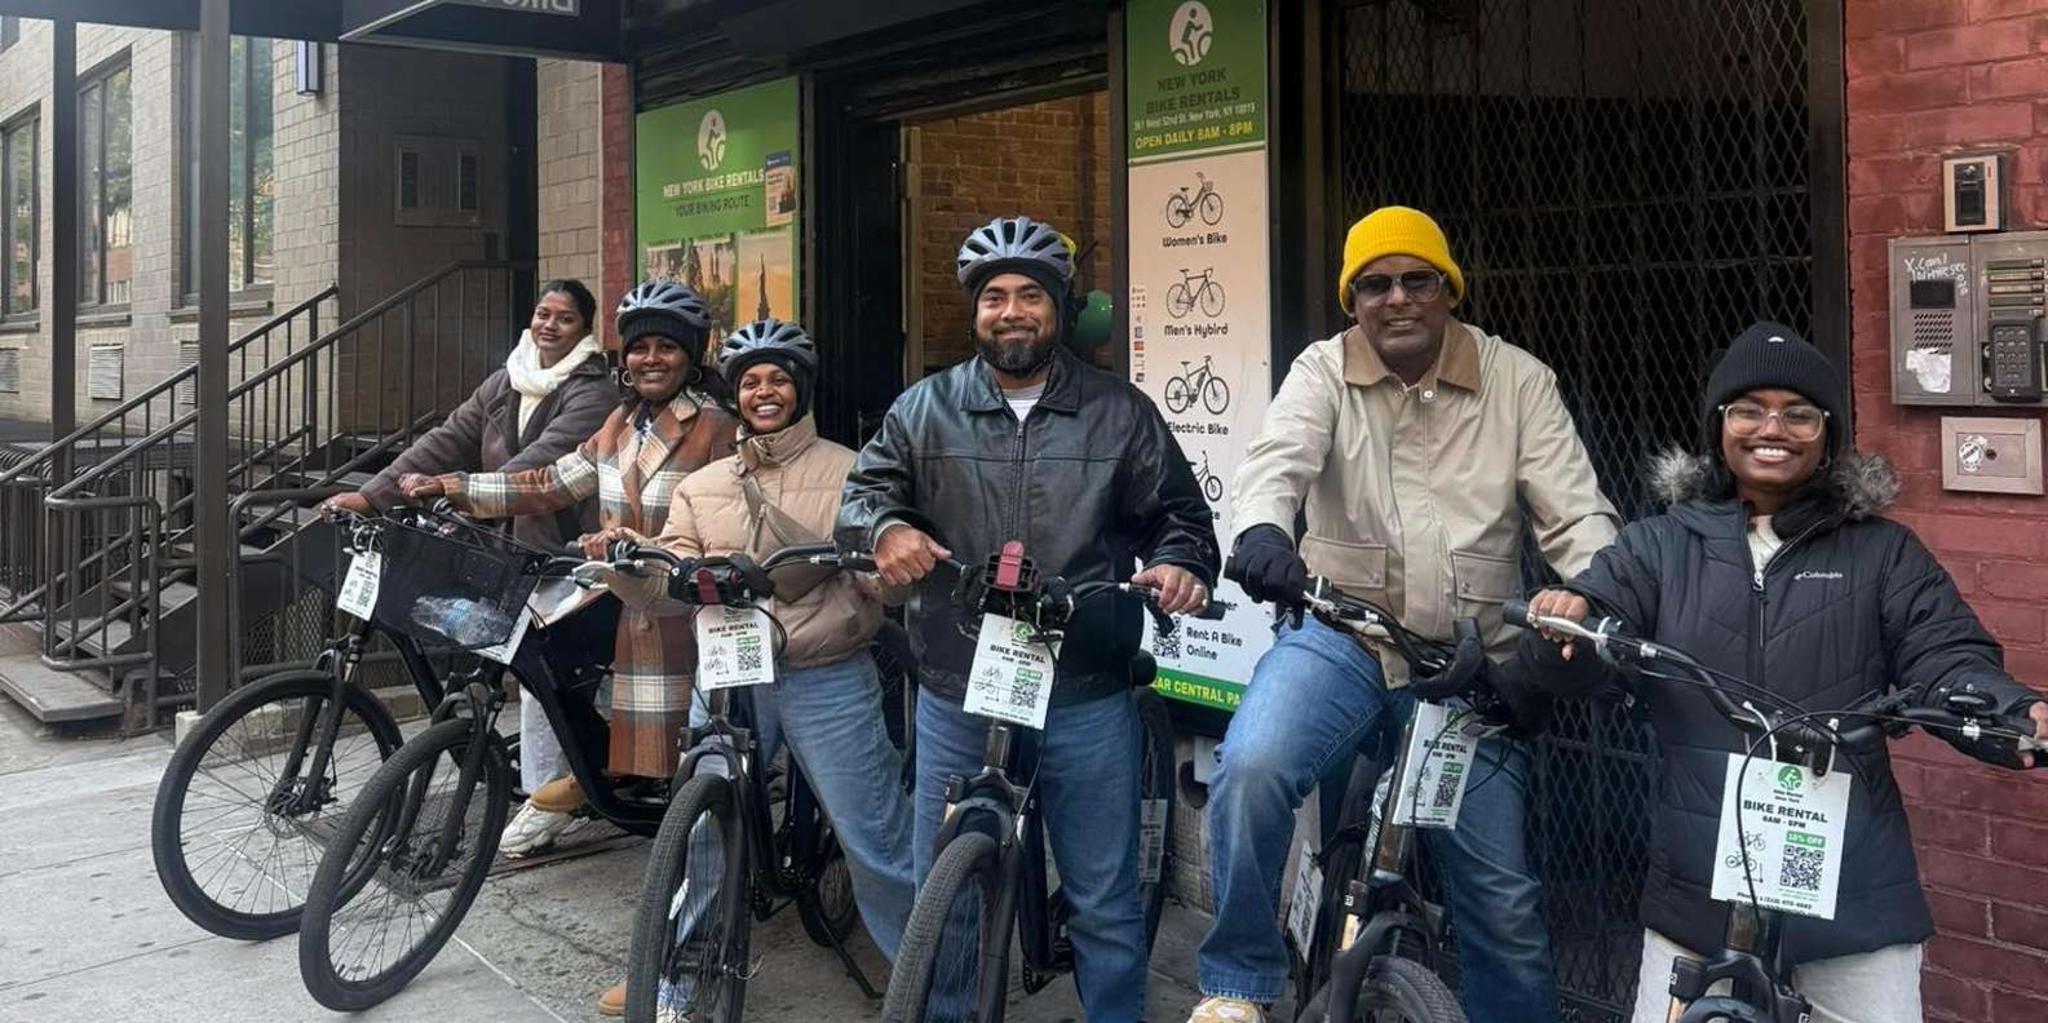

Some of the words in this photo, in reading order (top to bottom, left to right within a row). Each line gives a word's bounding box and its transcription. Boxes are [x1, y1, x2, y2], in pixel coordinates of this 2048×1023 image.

[1157, 77, 1187, 92] NEW
[1191, 68, 1227, 86] YORK
[1146, 98, 1177, 115] BIKE
[1179, 86, 1241, 110] RENTALS
[1135, 136, 1162, 150] OPEN
[1165, 130, 1196, 146] DAILY
[1197, 126, 1221, 142] 8AM
[1228, 121, 1253, 138] 8PM
[664, 184, 680, 198] NEW
[683, 179, 704, 195] YORK
[705, 175, 725, 192] BIKE
[726, 168, 765, 188] RENTALS
[723, 194, 751, 212] ROUTE
[1162, 234, 1204, 248] Women's
[1207, 232, 1228, 245] Bike
[1164, 324, 1192, 336] Men's
[1207, 423, 1229, 436] Bike
[1186, 626, 1210, 641] Rent
[1212, 631, 1219, 643] A
[1221, 633, 1243, 647] Bike
[1012, 649, 1046, 664] RENTAL
[1186, 644, 1218, 660] Online
[1174, 680, 1225, 703] CENTRAL
[1743, 800, 1774, 814] BIKE
[1777, 803, 1828, 823] RENTAL
